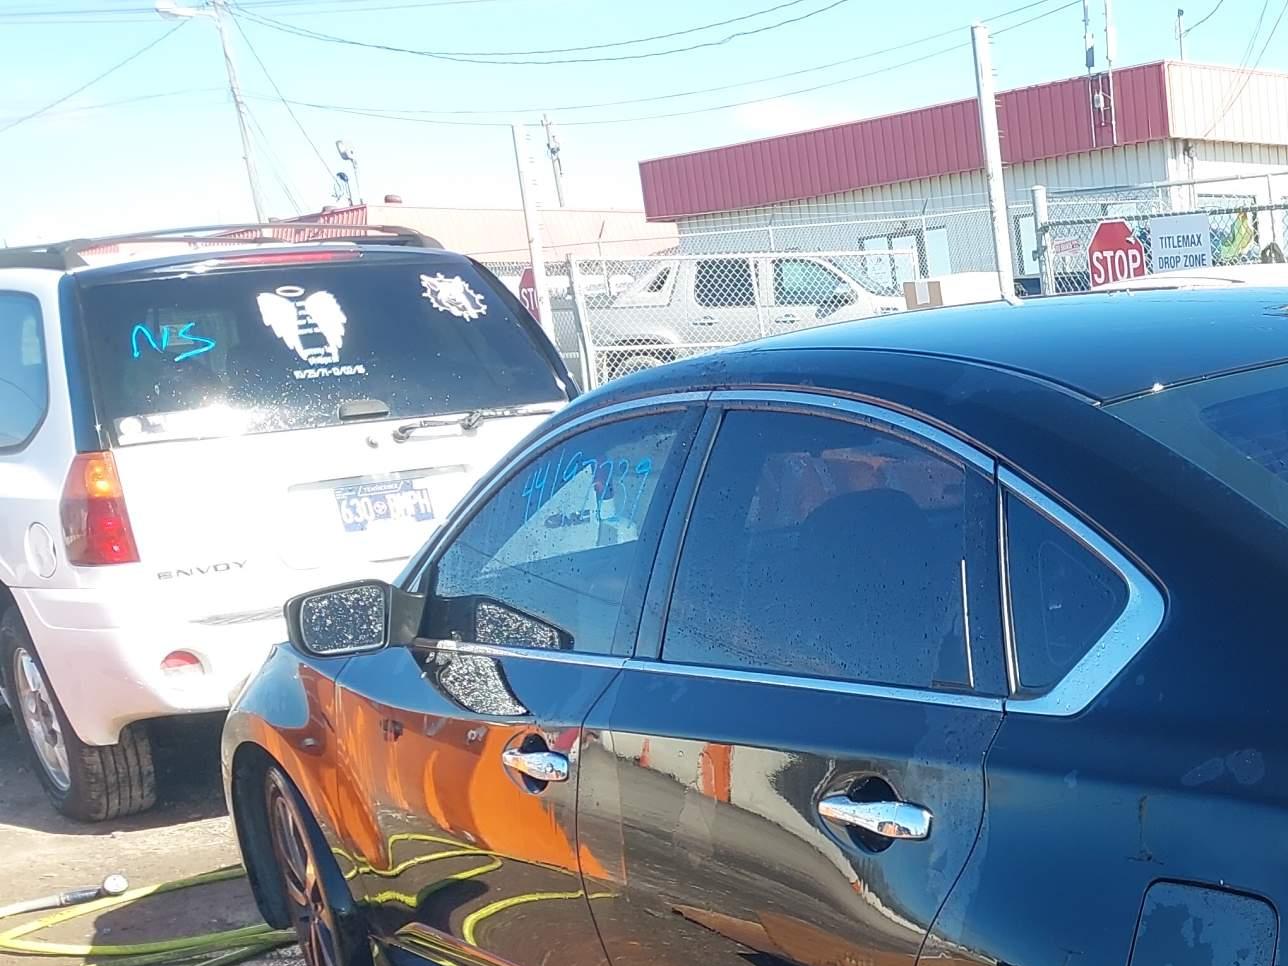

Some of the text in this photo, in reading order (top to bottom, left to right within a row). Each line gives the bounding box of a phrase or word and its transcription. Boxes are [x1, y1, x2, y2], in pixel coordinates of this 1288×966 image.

[1159, 233, 1202, 249] TITLEMAX
[1092, 249, 1141, 284] STOP
[1158, 253, 1207, 270] DROP ZONE
[157, 559, 247, 580] ENVOY
